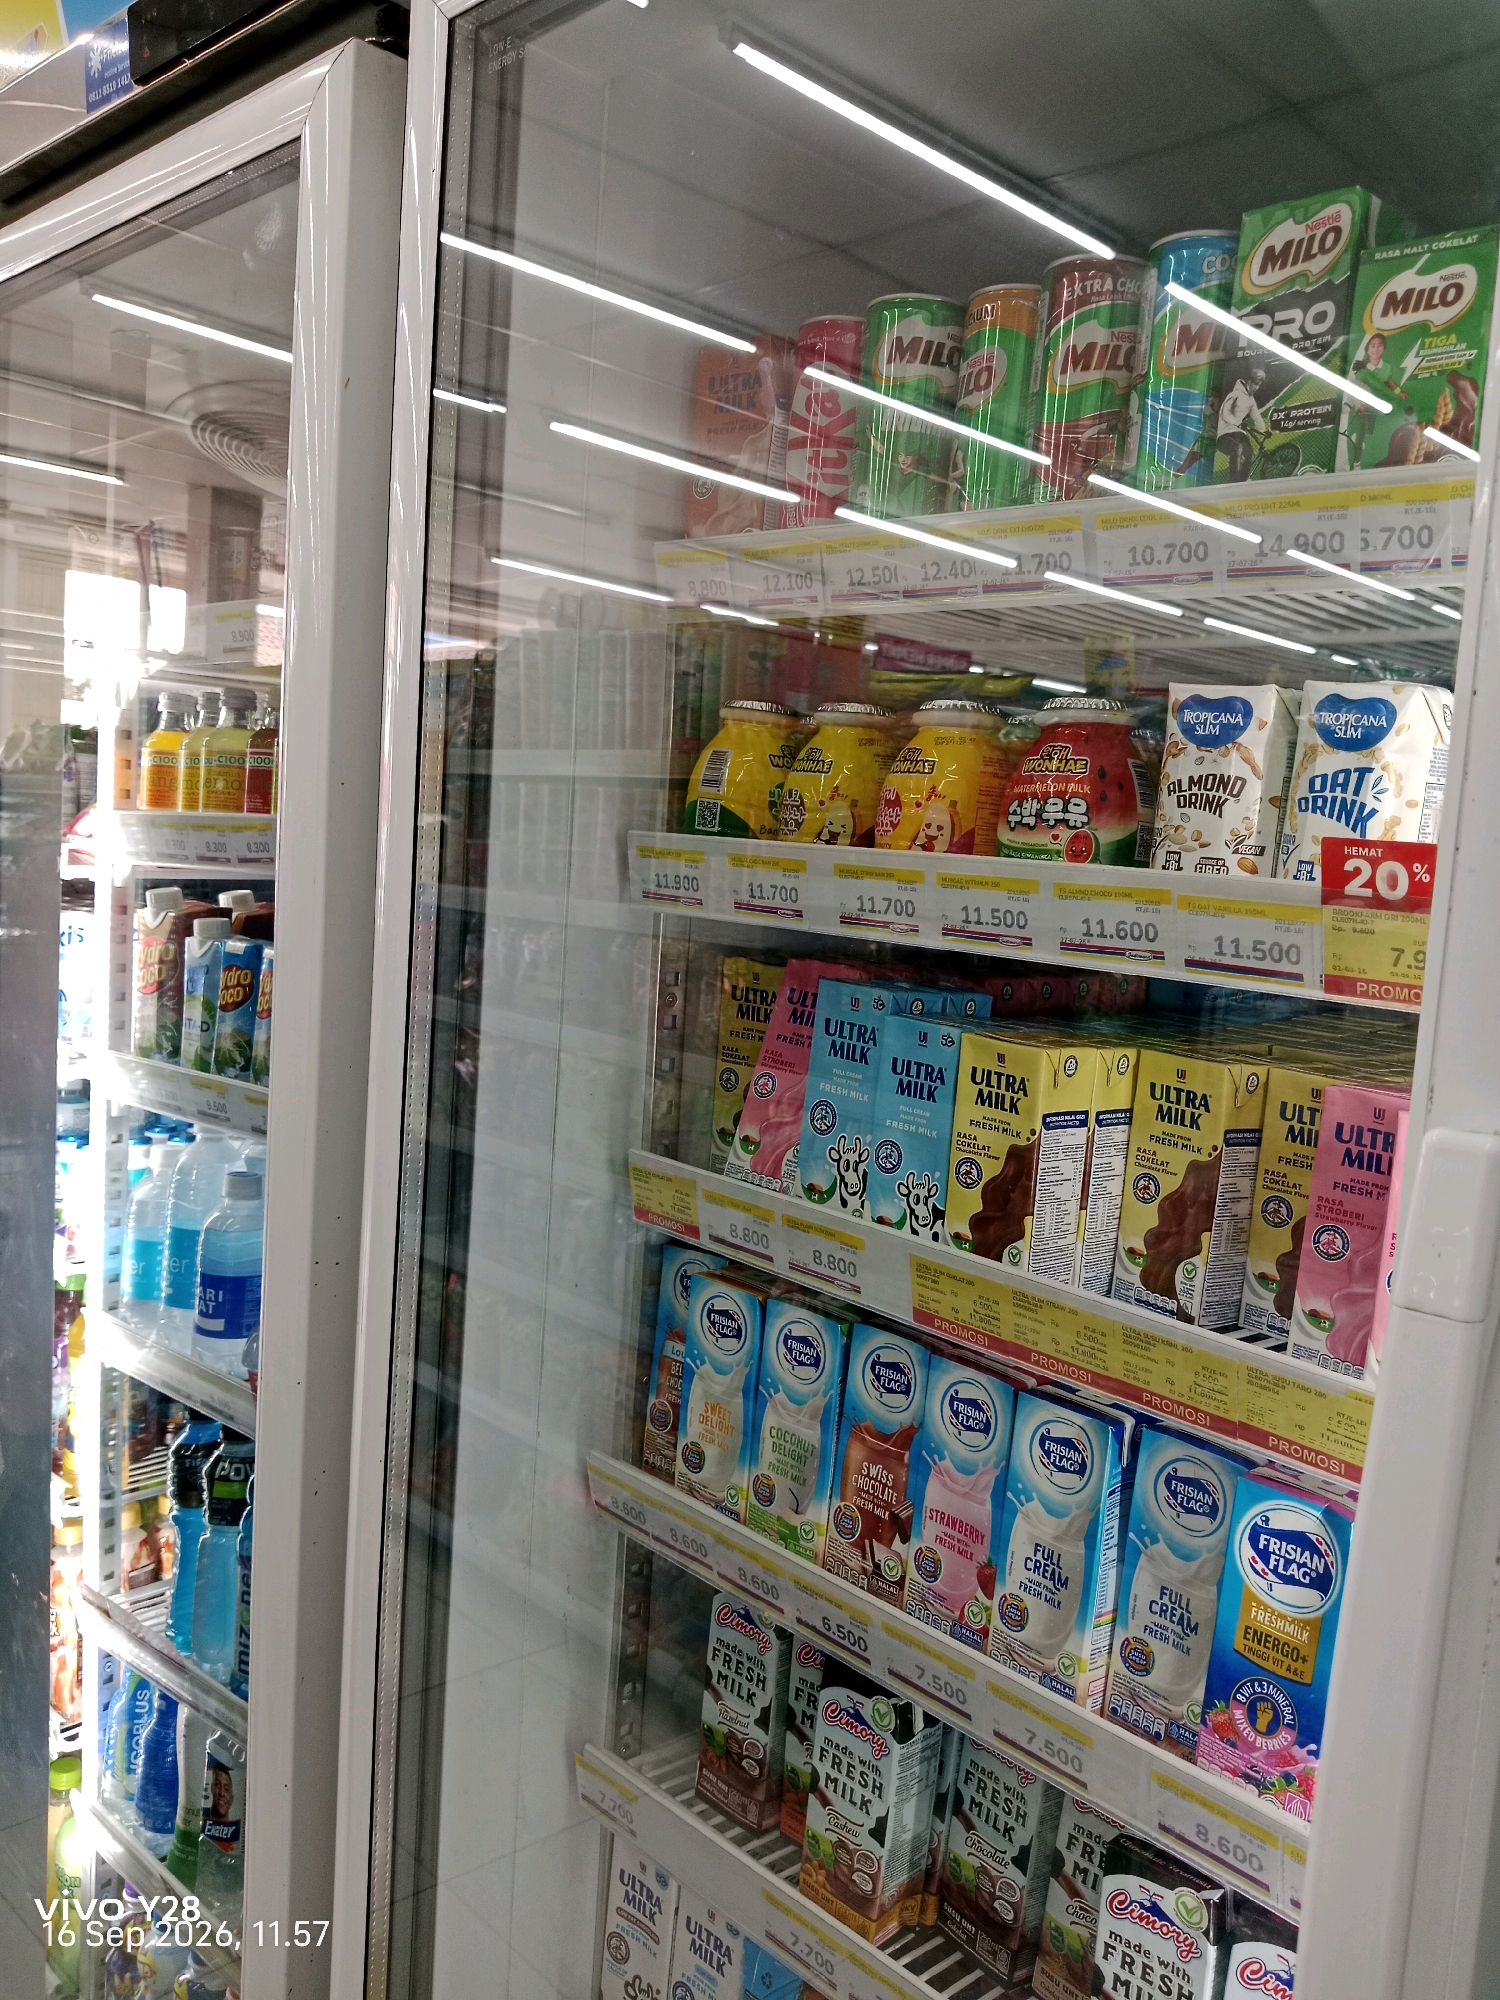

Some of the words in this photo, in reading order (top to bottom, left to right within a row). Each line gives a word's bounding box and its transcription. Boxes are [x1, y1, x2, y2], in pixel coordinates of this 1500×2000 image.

[1304, 209, 1342, 234] Nestlé
[1257, 224, 1343, 277] MILO
[1374, 249, 1400, 260] RASA
[1402, 244, 1430, 255] MALT
[1431, 234, 1479, 250] COKELAT
[1066, 277, 1113, 301] EXTRA
[1380, 282, 1464, 318] MILO
[1238, 300, 1336, 347] PRO
[1292, 335, 1331, 350] PROTEIN
[1423, 333, 1458, 348] TIGA
[708, 370, 762, 394] ULTRA
[1290, 404, 1332, 417] PROTEIN
[1127, 540, 1209, 567] 10.700
[1254, 529, 1346, 558] 14.900
[763, 569, 814, 593] 12.100
[1183, 709, 1243, 728] TROPICANA
[1194, 724, 1220, 736] SLIM
[1319, 713, 1387, 730] TROPICANA
[1334, 726, 1362, 739] SLIM
[1023, 758, 1088, 774] WONHAE
[1013, 782, 1066, 793] WATERMELON
[1067, 782, 1091, 794] MILK
[1167, 774, 1247, 799] ALMOND
[1308, 767, 1376, 798] OAT
[1176, 794, 1230, 819] DRINK
[1297, 794, 1380, 839] DRINK
[1166, 852, 1180, 862] LOW
[1238, 846, 1262, 855] VEGAN
[1344, 845, 1383, 857] HEMAT
[1165, 859, 1180, 871] FAT
[1298, 862, 1312, 872] LOW
[655, 872, 700, 892] 11.900
[748, 882, 799, 904] 11.700
[856, 895, 916, 918] 11.700
[960, 905, 1029, 930] 11.500
[1210, 905, 1242, 914] VANILLA
[1332, 908, 1382, 921] BROOKFARM
[1384, 913, 1399, 921] ORI
[1401, 915, 1427, 925] 200ML
[1081, 917, 1159, 943] 11.600
[139, 942, 175, 967] ydro
[1213, 935, 1301, 966] 11.500
[139, 964, 167, 987] oco
[221, 967, 253, 987] ydro
[220, 987, 244, 1004] oco
[824, 1017, 878, 1047] ULTRA
[721, 1051, 750, 1062] COKELAT
[762, 1055, 796, 1069] STROBERI
[828, 1039, 872, 1066] MILK
[891, 1056, 946, 1086] ULTRA
[970, 1066, 1029, 1098] ULTRA
[849, 1089, 869, 1102] MILK
[895, 1080, 940, 1103] MILK
[1149, 1081, 1211, 1114] ULTRA
[917, 1126, 937, 1139] MILK
[956, 1131, 978, 1143] RASA
[1002, 1127, 1022, 1140] MILK
[955, 1139, 992, 1152] COKELAT
[955, 1146, 982, 1158] Chocolate
[1136, 1146, 1157, 1158] RASA
[1180, 1143, 1203, 1155] MILK
[1134, 1161, 1161, 1173] Chocolate
[1263, 1168, 1288, 1180] RASA
[1262, 1184, 1293, 1196] Chocolate
[1350, 1177, 1372, 1188] MADE
[1315, 1204, 1365, 1222] STROBERI
[1317, 1195, 1344, 1208] RASA
[648, 1213, 686, 1233] PROMOSI
[729, 1223, 770, 1250] 8.800
[812, 1249, 858, 1278] 8.800
[711, 1312, 739, 1330] FRISIAN
[934, 1318, 989, 1347] PROMOSI
[787, 1339, 817, 1358] FRISIAN
[875, 1365, 908, 1384] FRISIAN
[1031, 1352, 1092, 1384] PROMOSI
[1271, 1374, 1291, 1386] SUSU
[704, 1401, 732, 1421] SWEET
[953, 1401, 987, 1421] FRISIAN
[1142, 1392, 1210, 1427] PROMOSI
[698, 1413, 735, 1436] DELIGHT
[769, 1426, 817, 1457] COCONUT
[1044, 1440, 1082, 1464] FRISIAN
[771, 1441, 809, 1468] DELIGHT
[1268, 1435, 1346, 1477] PROMOSI
[861, 1461, 894, 1486] SWISS
[852, 1474, 898, 1505] CHOCOLATE
[1170, 1480, 1213, 1506] FRISIAN
[611, 1495, 646, 1526] 8.600
[928, 1507, 986, 1546] STRAWBERRY
[1033, 1542, 1063, 1571] FULL
[738, 1567, 780, 1601] 8.600
[1023, 1556, 1070, 1591] CREAM
[878, 1580, 898, 1594] HALAL
[1159, 1585, 1192, 1615] FULL
[715, 1602, 772, 1655] Cimory
[1148, 1600, 1199, 1638] CREAM
[821, 1616, 868, 1652] 6.500
[1243, 1624, 1309, 1665] ENERGO+
[716, 1637, 744, 1657] made
[746, 1653, 766, 1672] with
[1242, 1643, 1270, 1663] TINGGI
[1271, 1655, 1284, 1669] VIT
[914, 1664, 967, 1706] 7.500
[1236, 1690, 1247, 1703] 8
[1267, 1682, 1295, 1725] MINERAL
[718, 1707, 749, 1729] Hazelnut
[823, 1699, 890, 1760] Cimory
[1233, 1709, 1255, 1745] MIXED
[1255, 1731, 1291, 1750] BERRIES
[824, 1736, 854, 1759] made
[858, 1755, 882, 1778] with
[1025, 1728, 1083, 1774] 7.500
[969, 1758, 1000, 1784] made
[1003, 1780, 1026, 1805] with
[827, 1815, 861, 1838] Cashew
[964, 1835, 1011, 1870] Chocolate
[1195, 1822, 1264, 1873] 8.600
[943, 1902, 961, 1922] SUSU
[1106, 1889, 1202, 1963] Cimory
[790, 1931, 835, 1976] 7.700
[1109, 1930, 1151, 1959] made
[1157, 1955, 1191, 1984] with
[1039, 1965, 1060, 1986] SUSU
